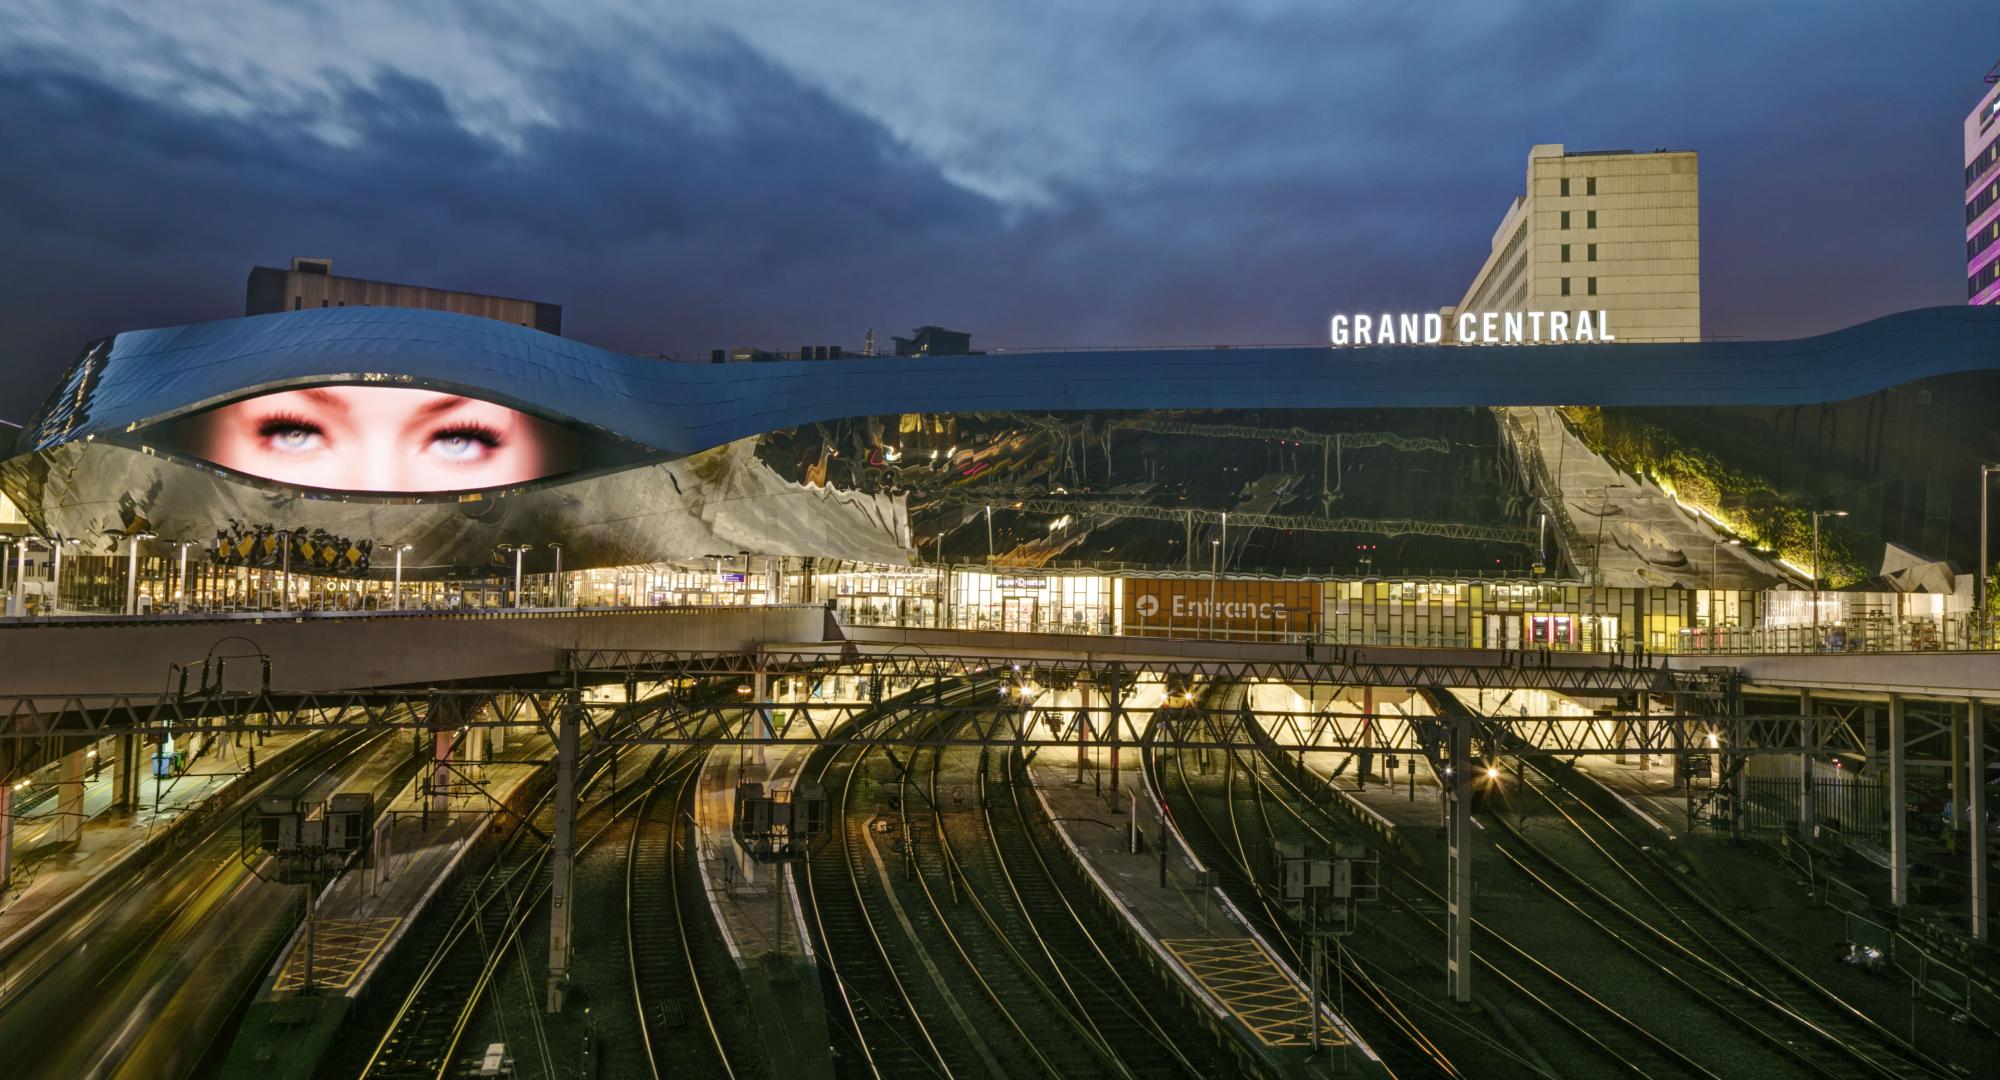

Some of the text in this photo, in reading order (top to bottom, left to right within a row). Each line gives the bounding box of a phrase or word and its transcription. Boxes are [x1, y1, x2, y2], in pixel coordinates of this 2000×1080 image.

[1331, 310, 1615, 345] GRAND CENTRAL
[277, 580, 310, 590] BAR
[326, 581, 363, 591] ONE
[1172, 594, 1287, 619] Entrance
